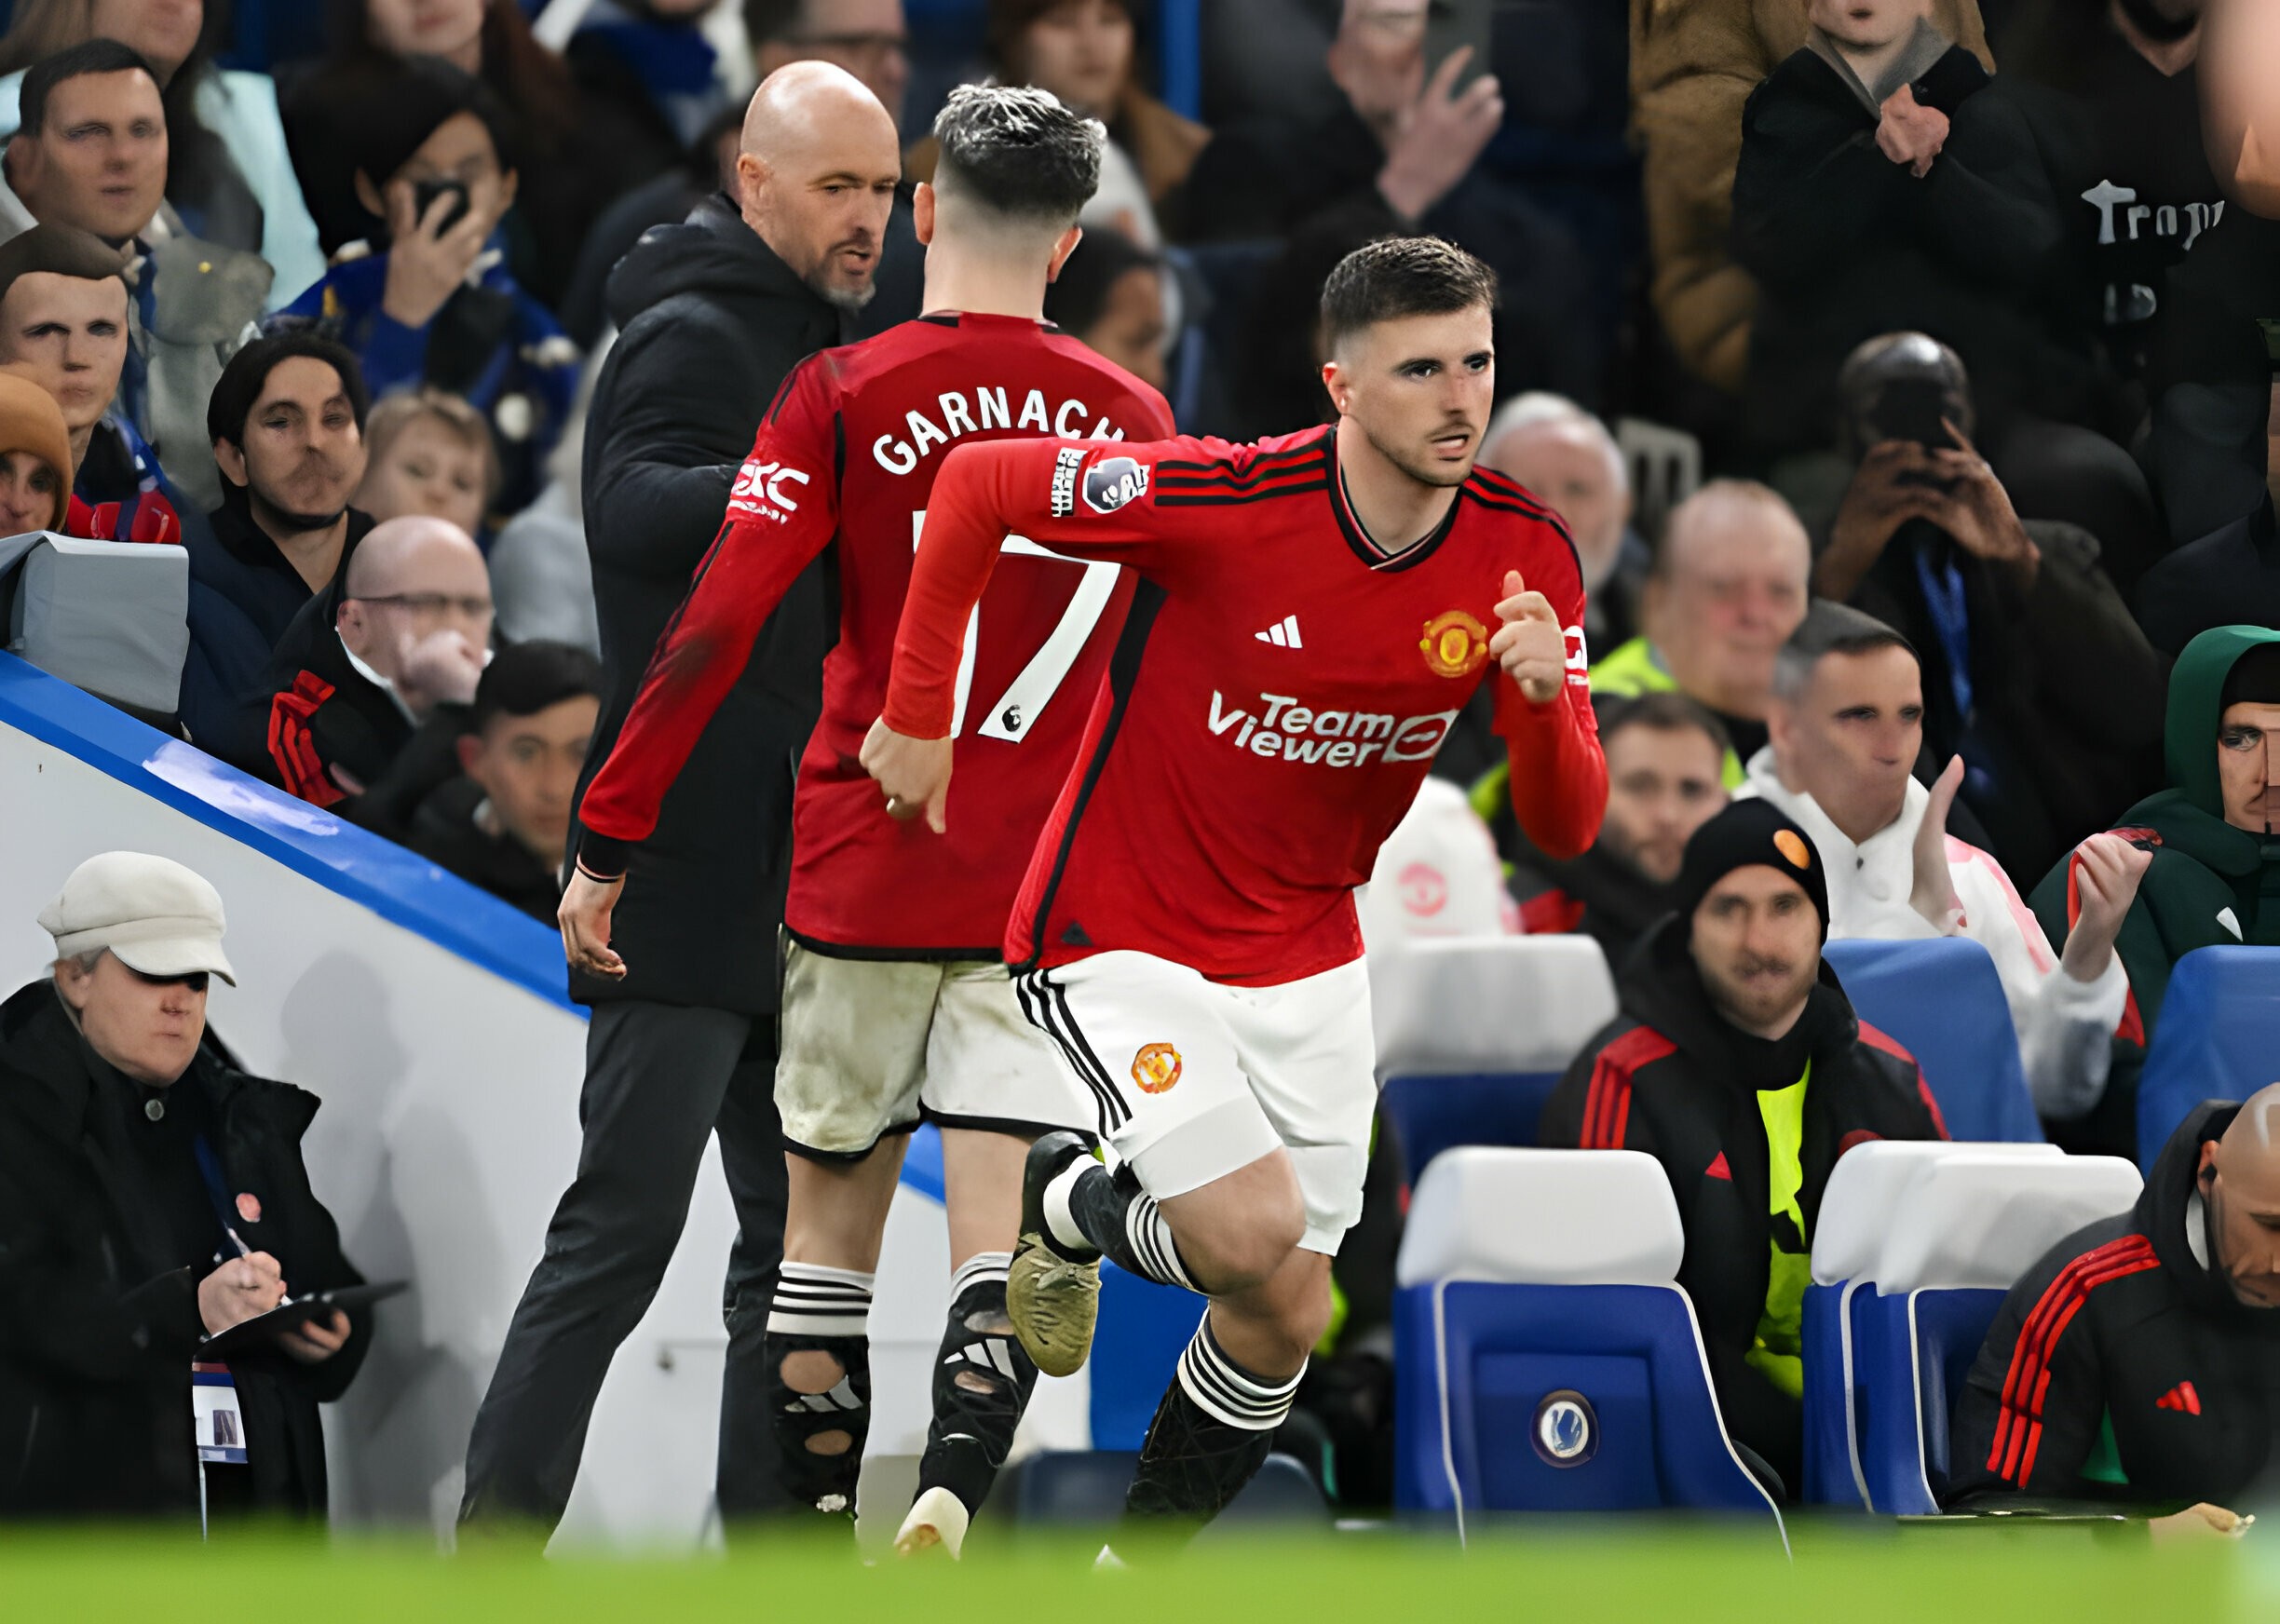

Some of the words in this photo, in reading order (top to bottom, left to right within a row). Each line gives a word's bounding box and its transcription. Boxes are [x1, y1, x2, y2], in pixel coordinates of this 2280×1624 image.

[913, 510, 1121, 744] 7
[1208, 689, 1384, 768] Viewer
[1259, 692, 1396, 739] Team
